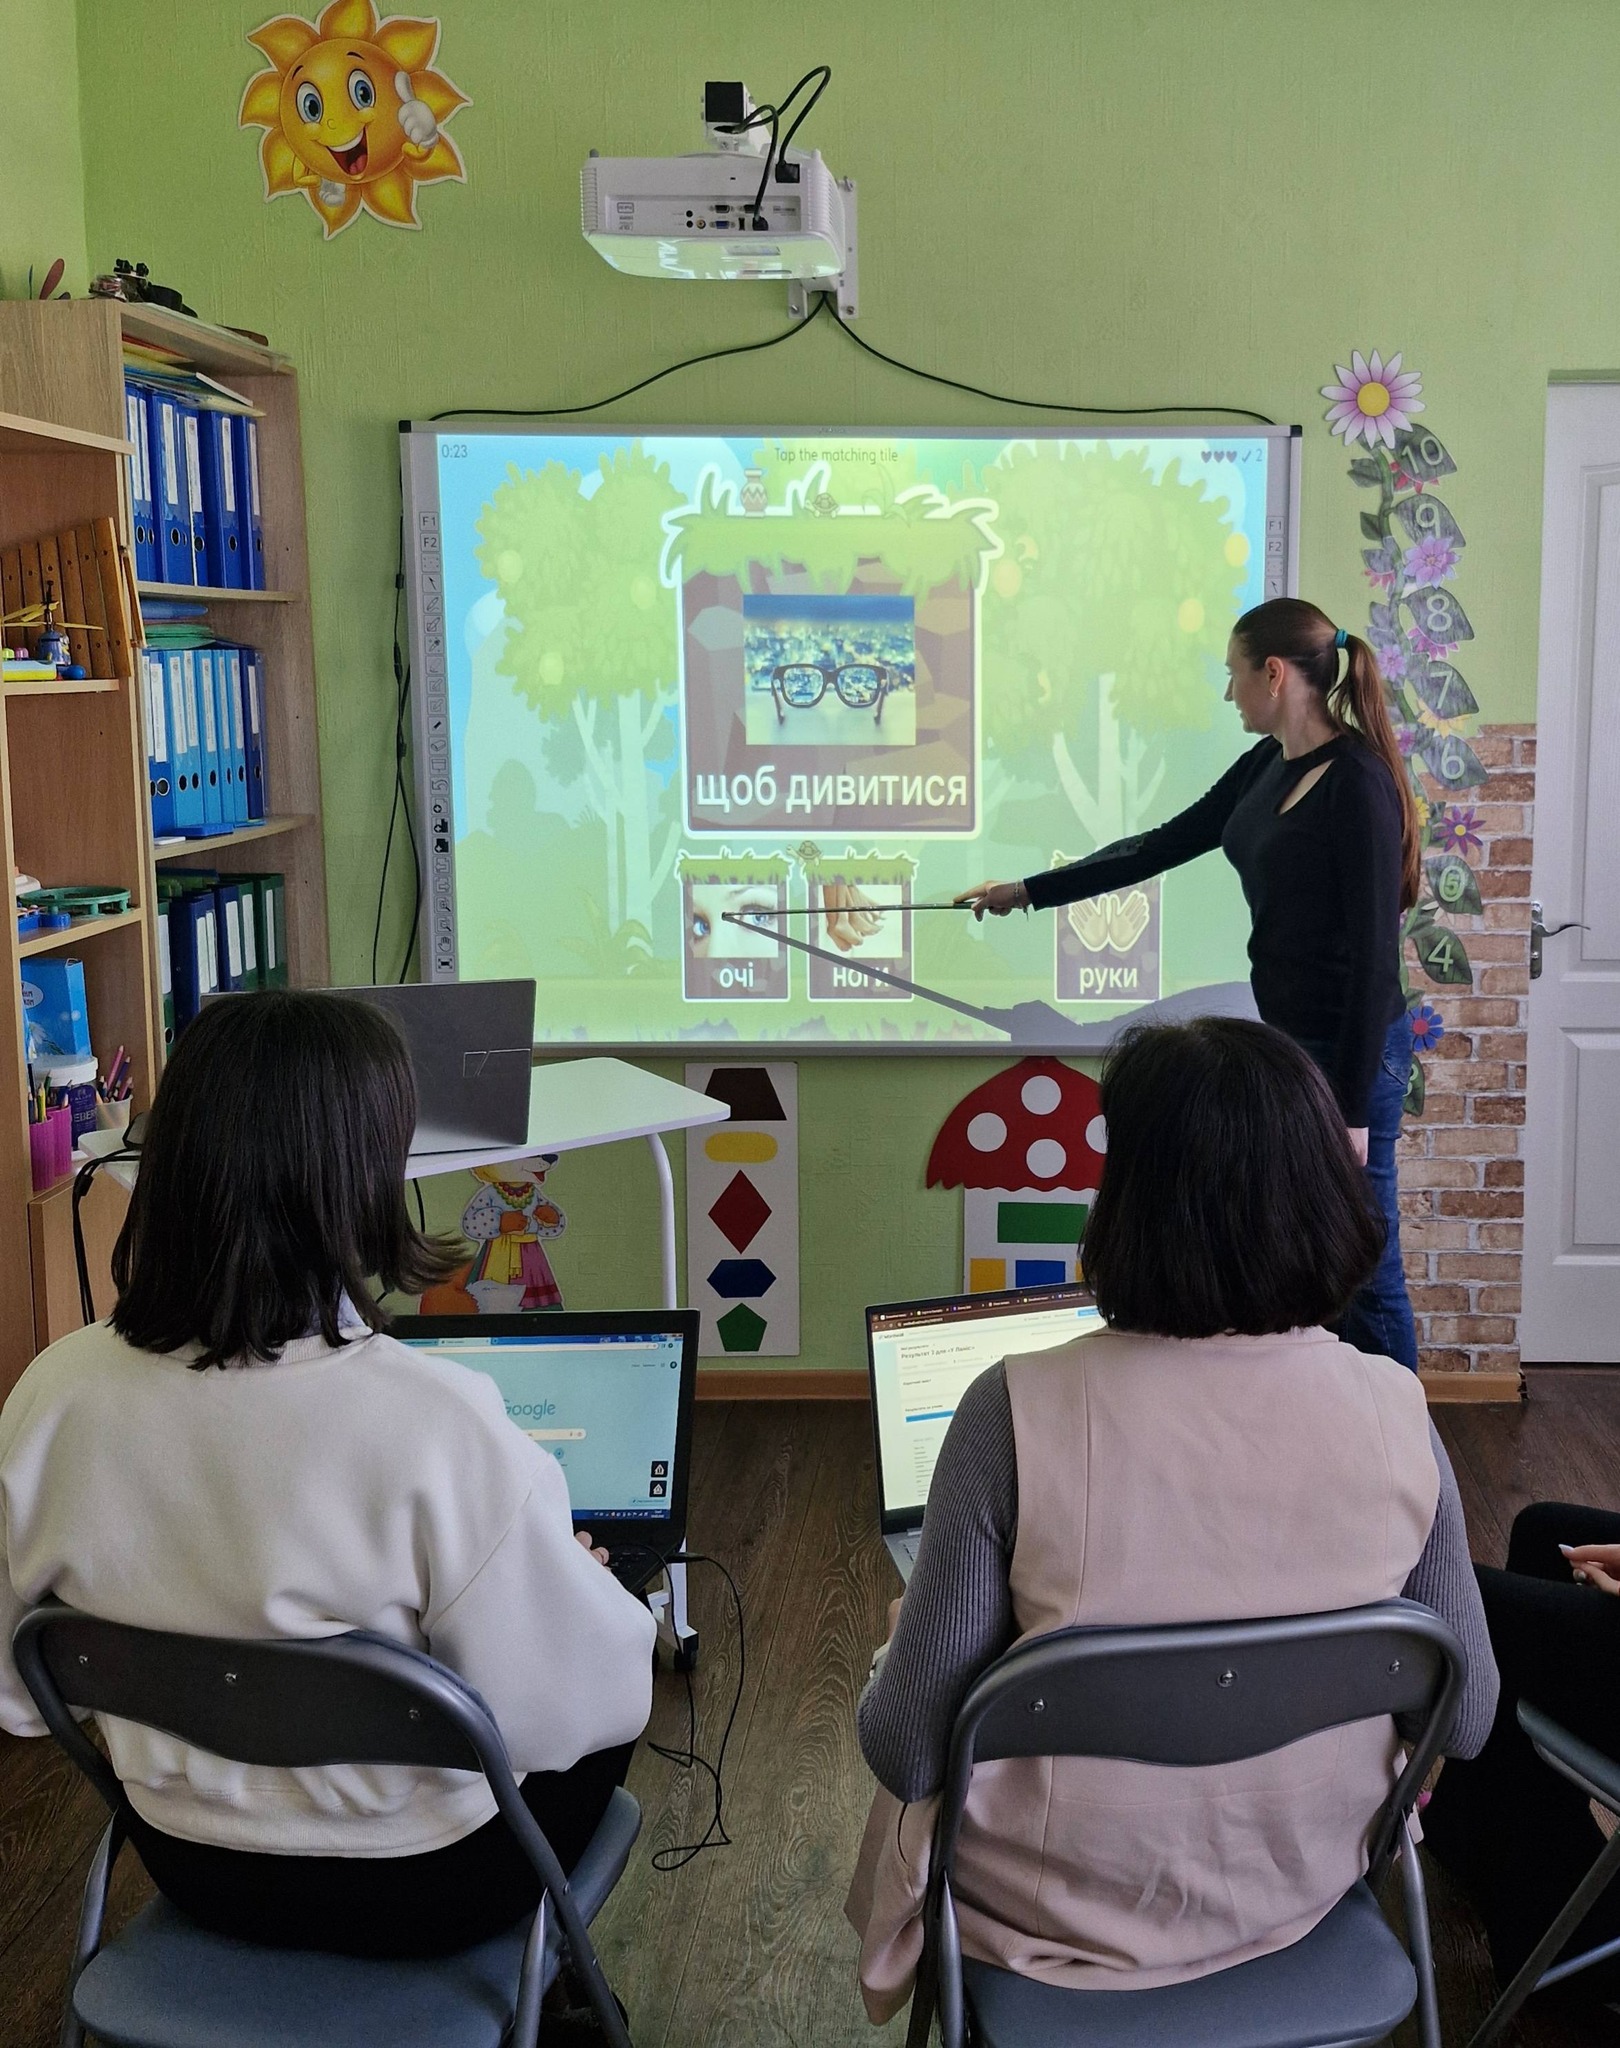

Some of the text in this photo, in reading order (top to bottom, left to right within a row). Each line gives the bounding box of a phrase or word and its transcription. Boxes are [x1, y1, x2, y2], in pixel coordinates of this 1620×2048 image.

[441, 444, 468, 458] 0:23
[774, 447, 898, 465] Tap the matching tile
[1255, 448, 1263, 462] 2
[1401, 436, 1444, 474] 10
[422, 516, 436, 526] F1
[1268, 521, 1282, 531] F1
[1415, 503, 1441, 539] 9
[423, 537, 437, 548] F2
[1268, 542, 1282, 552] F2
[1426, 594, 1452, 632] 8
[1430, 670, 1453, 709] 7
[1441, 742, 1465, 780] 6
[696, 765, 967, 814] щоб дивитися
[1428, 935, 1454, 972] 4
[719, 961, 754, 988] очі
[1080, 967, 1137, 994] руки
